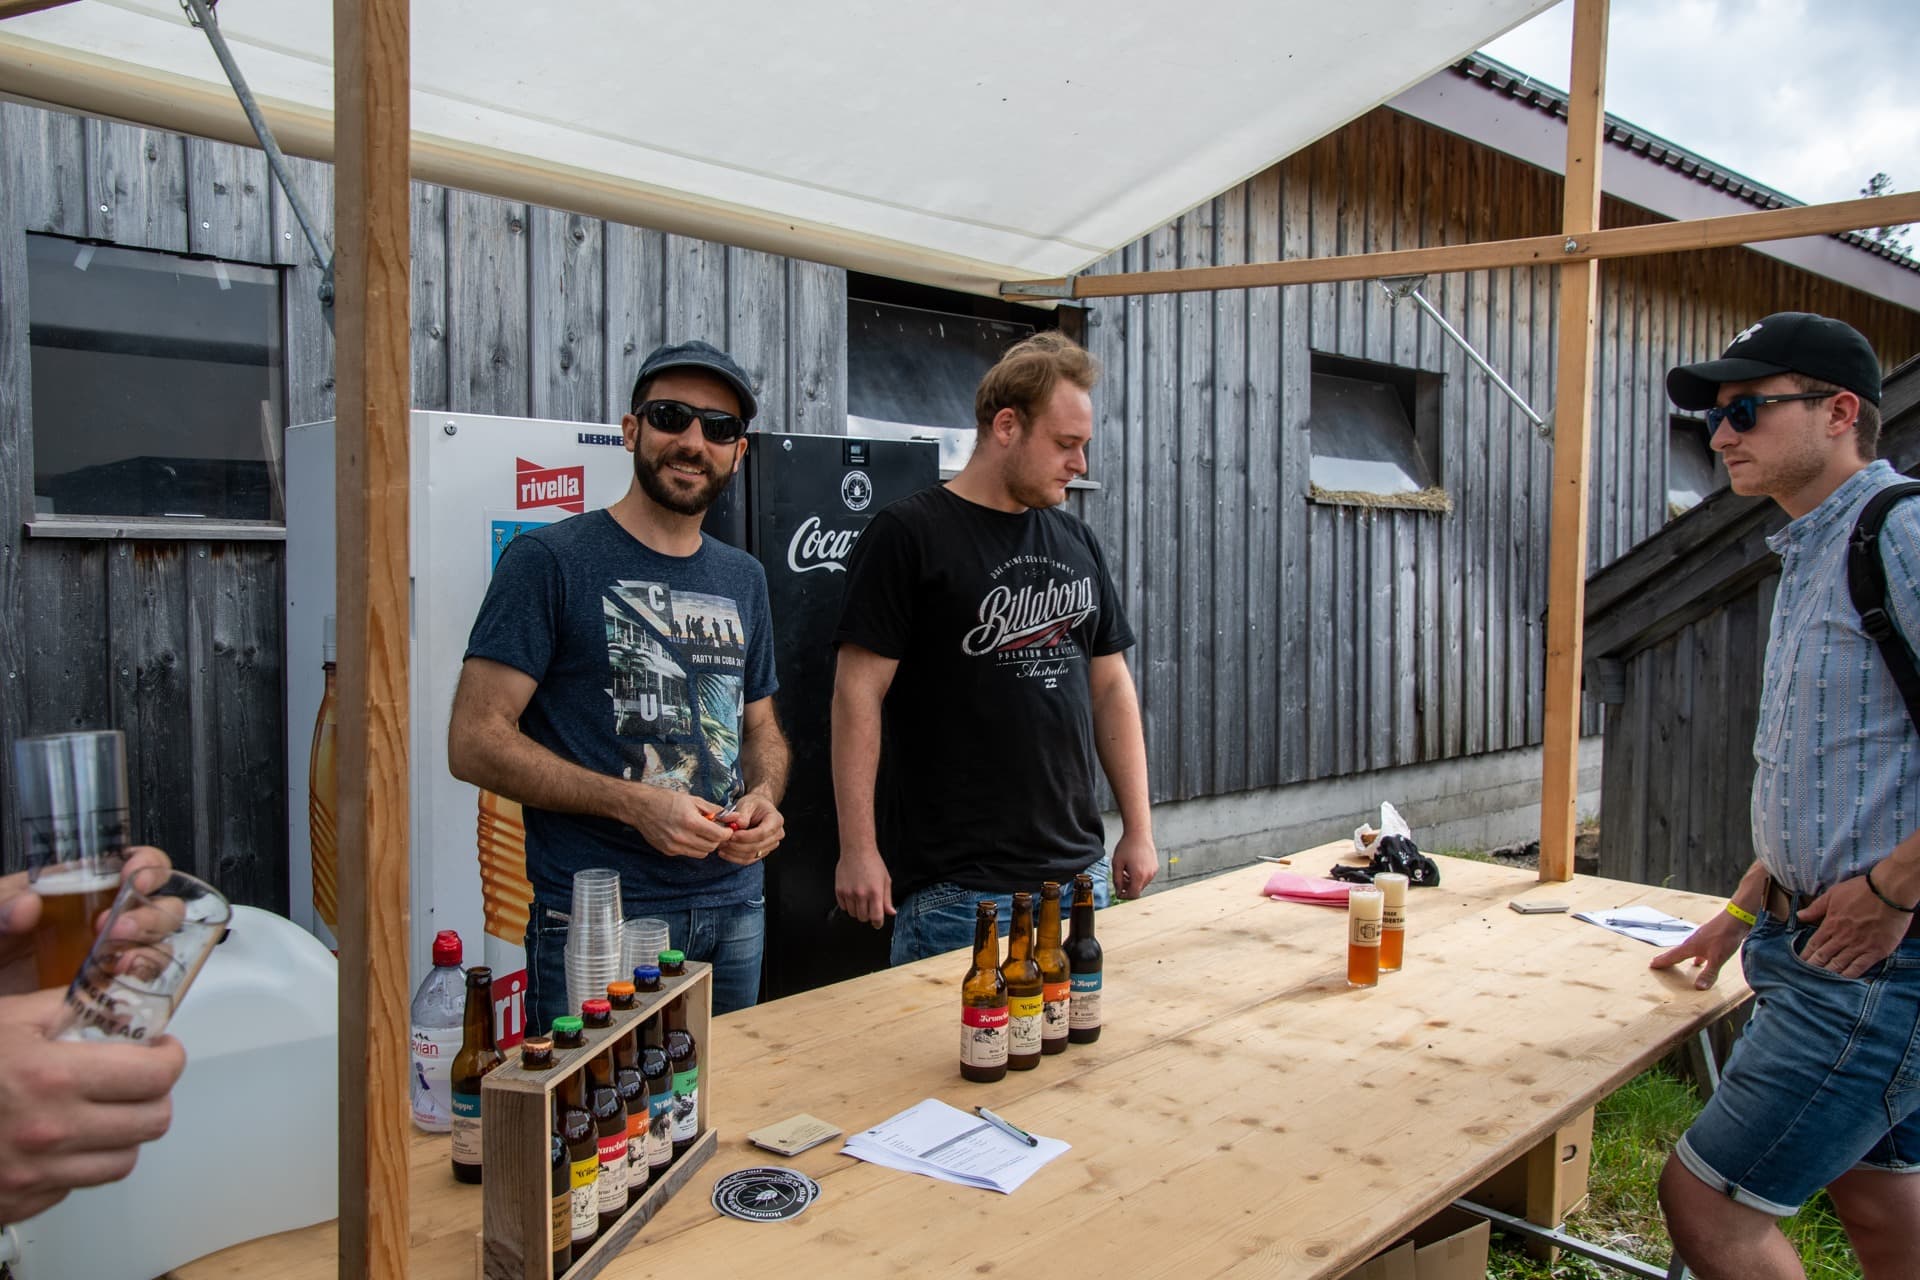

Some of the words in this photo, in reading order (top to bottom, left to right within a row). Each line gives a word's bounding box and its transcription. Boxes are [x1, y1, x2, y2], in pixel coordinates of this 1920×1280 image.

[521, 474, 580, 503] rivella
[648, 585, 666, 612] C
[962, 577, 1098, 656] Billabong
[692, 654, 712, 664] PARTY
[714, 655, 721, 665] IN
[722, 655, 736, 666] CUBA
[1016, 659, 1069, 678] Australia
